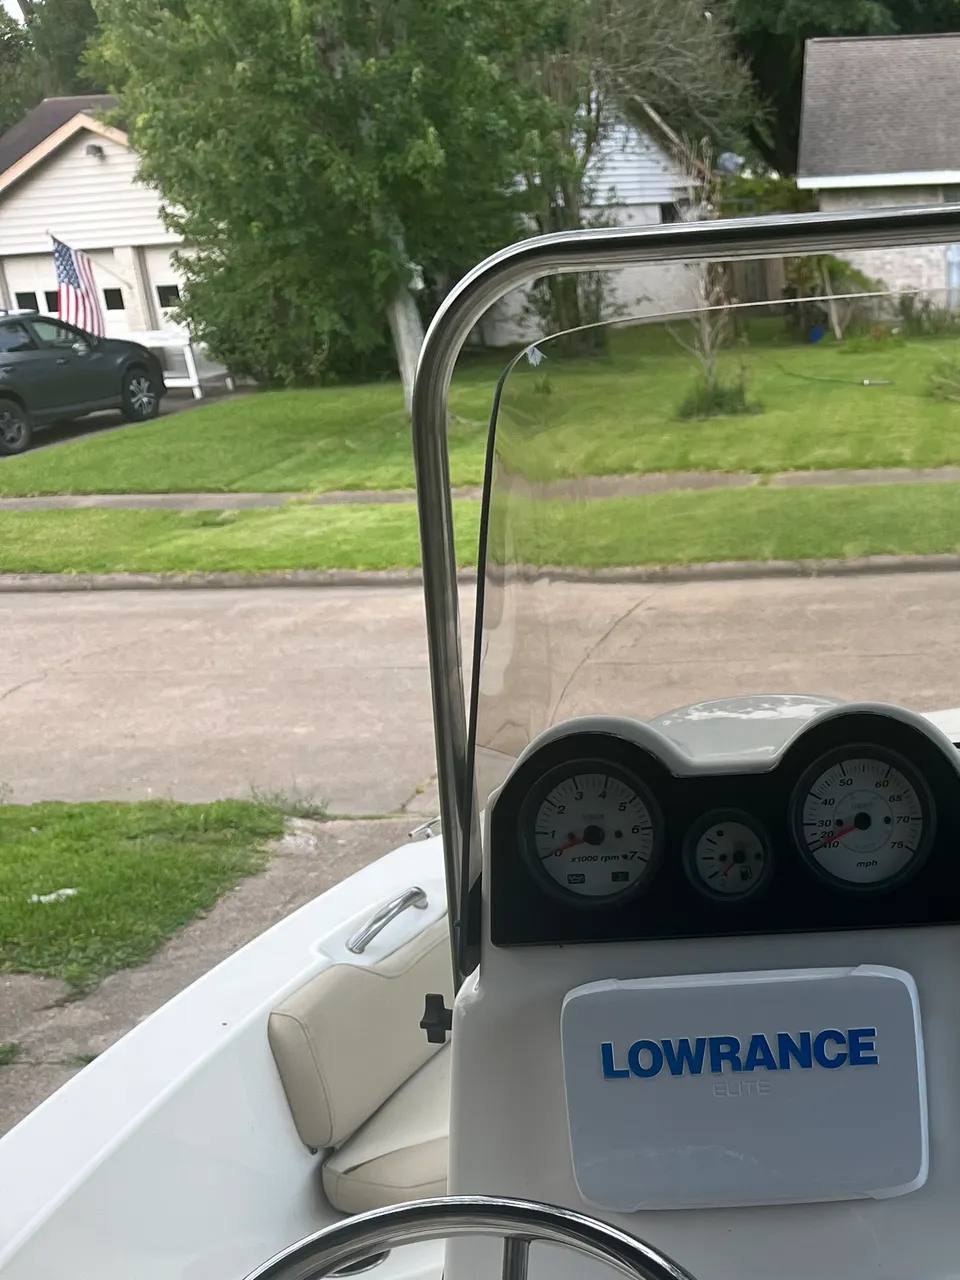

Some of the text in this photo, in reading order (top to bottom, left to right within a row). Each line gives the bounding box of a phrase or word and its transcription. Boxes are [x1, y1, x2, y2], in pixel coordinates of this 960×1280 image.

[839, 779, 853, 787] 50
[575, 791, 584, 800] 3
[598, 790, 606, 799] 4
[618, 802, 628, 811] 5
[821, 798, 835, 806] 40
[557, 805, 566, 814] 2
[631, 825, 640, 834] 6
[550, 830, 556, 839] 1
[629, 851, 638, 860] 7
[856, 860, 878, 868] mph
[600, 1027, 879, 1080] LOWRANCE
[712, 1081, 772, 1098] ELITE
